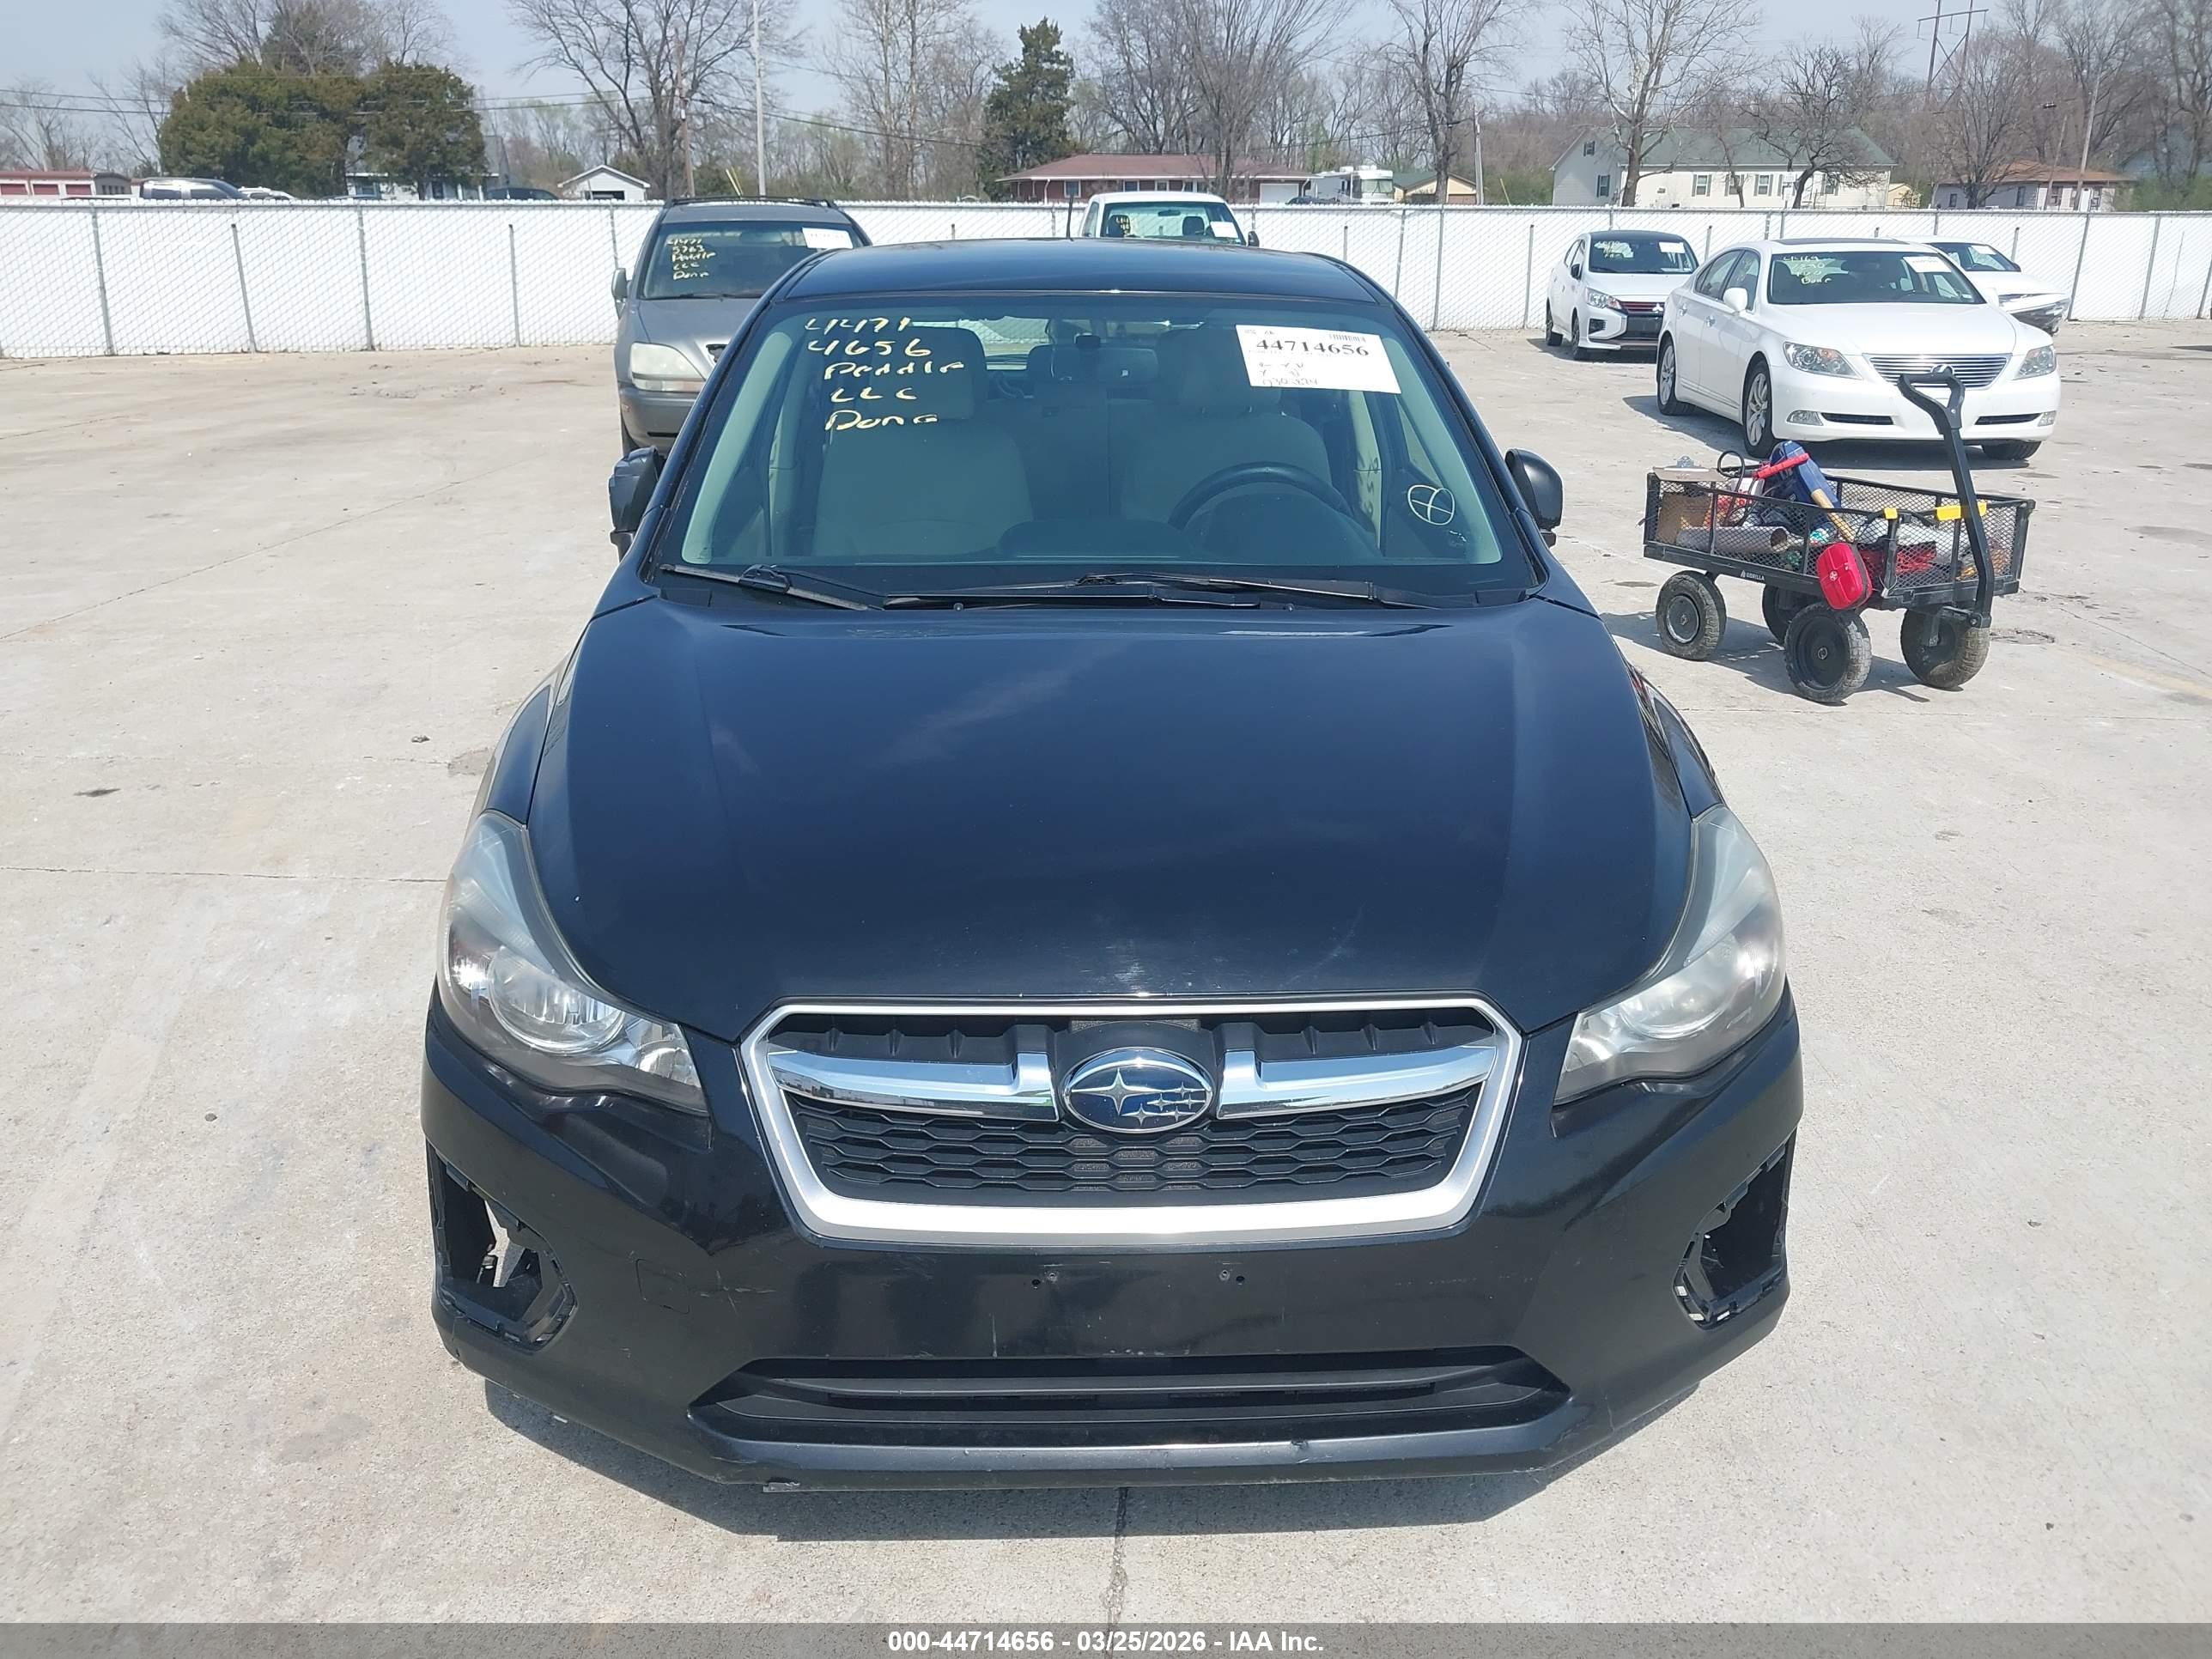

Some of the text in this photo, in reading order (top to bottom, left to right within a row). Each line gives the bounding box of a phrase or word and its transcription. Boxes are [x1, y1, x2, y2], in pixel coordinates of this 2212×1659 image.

[805, 316, 911, 336] 4471
[807, 337, 932, 357] 4656
[1256, 338, 1370, 357] 44714656
[830, 386, 918, 404] LLC
[1746, 572, 1765, 581] GORILLA
